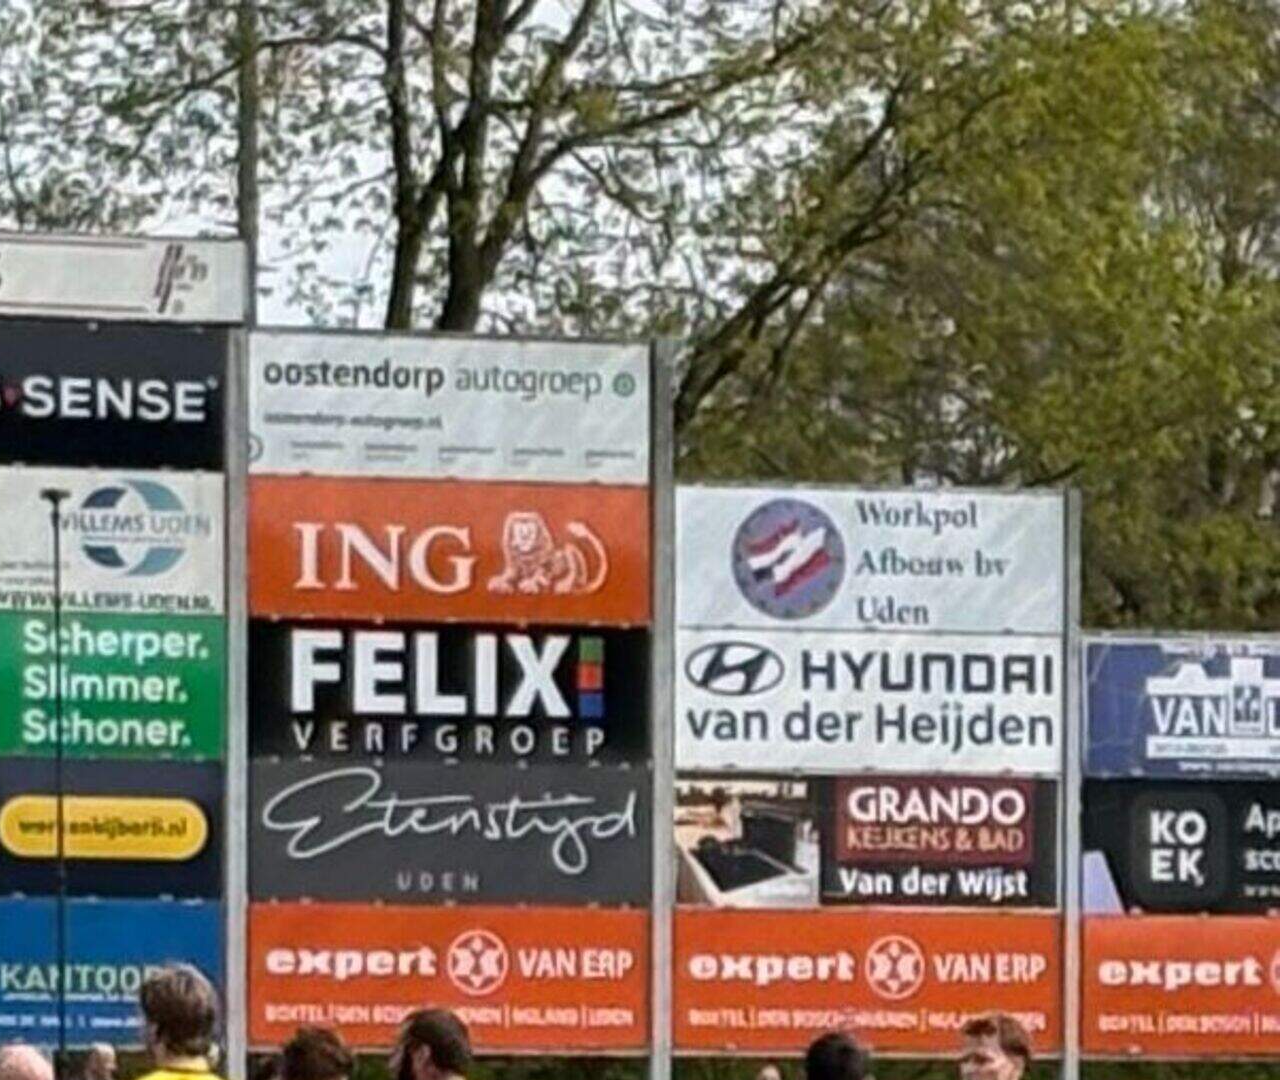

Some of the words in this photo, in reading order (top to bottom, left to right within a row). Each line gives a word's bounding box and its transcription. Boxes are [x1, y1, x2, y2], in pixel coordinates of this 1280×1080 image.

[264, 359, 445, 397] oostendorp
[455, 366, 603, 402] autogroep
[150, 514, 211, 538] UDEN
[854, 501, 978, 534] Workpol
[292, 521, 477, 593] ING
[854, 549, 964, 578] Afbouw
[974, 552, 1010, 578] bv
[854, 600, 930, 626] Uden
[22, 620, 209, 665] Scherper.
[22, 665, 188, 703] Slimmer.
[290, 630, 572, 718] FELIX
[800, 649, 1053, 695] HYUNDAI
[22, 709, 192, 747] Schoner.
[686, 709, 768, 741] van
[784, 704, 861, 743] der
[875, 704, 1054, 752] Heijden
[1151, 697, 1226, 735] VAN
[293, 722, 606, 756] VERFGROEP
[847, 786, 1027, 825] GRANDO
[954, 827, 974, 852] &
[978, 829, 1023, 853] BAD
[1150, 810, 1208, 846] KO
[397, 870, 480, 892] UDEN
[838, 866, 894, 897] Van
[902, 866, 949, 898] der
[962, 867, 1028, 902] Wijst
[265, 946, 438, 980] expert
[518, 949, 577, 979] VAN
[688, 952, 855, 986] expert
[934, 954, 991, 983] VAN
[995, 954, 1047, 983] ERP
[1098, 955, 1264, 990] expert
